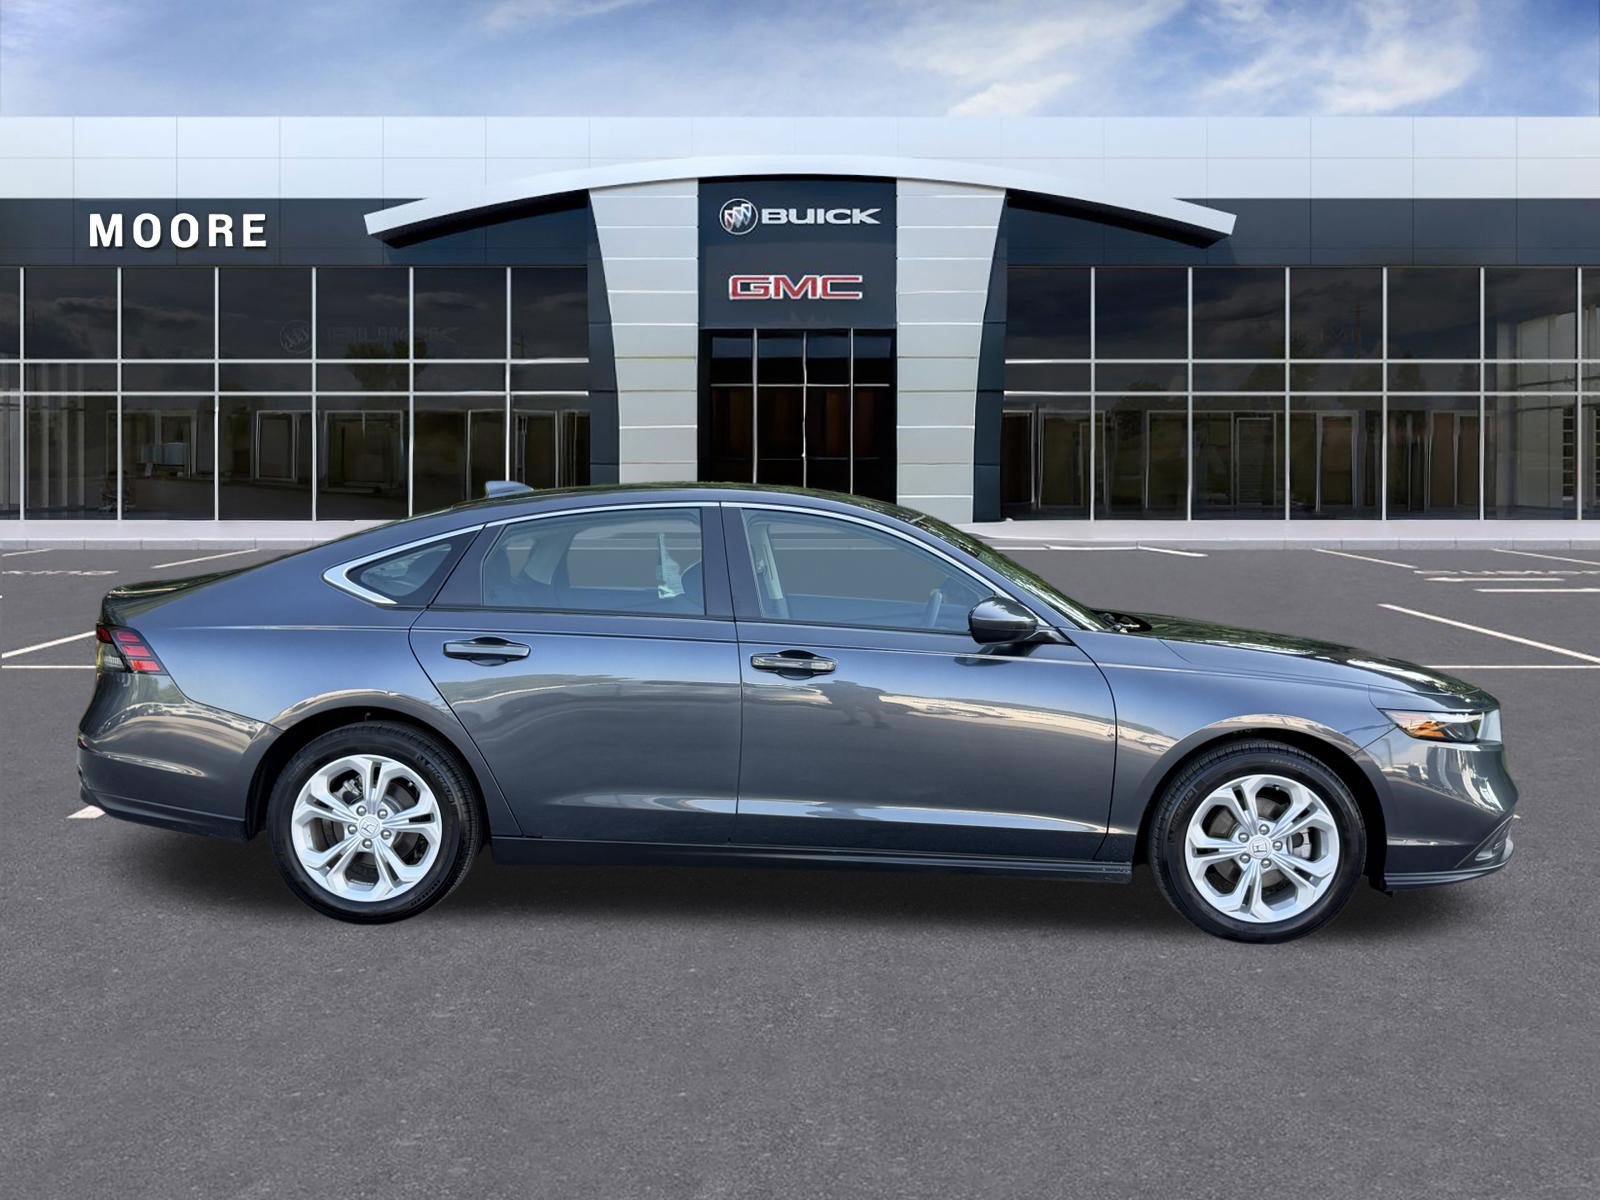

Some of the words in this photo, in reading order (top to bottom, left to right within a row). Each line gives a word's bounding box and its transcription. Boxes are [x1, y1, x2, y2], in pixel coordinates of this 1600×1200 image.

[761, 208, 881, 224] BUICK
[89, 213, 267, 248] MOORE
[729, 275, 863, 300] GMC
